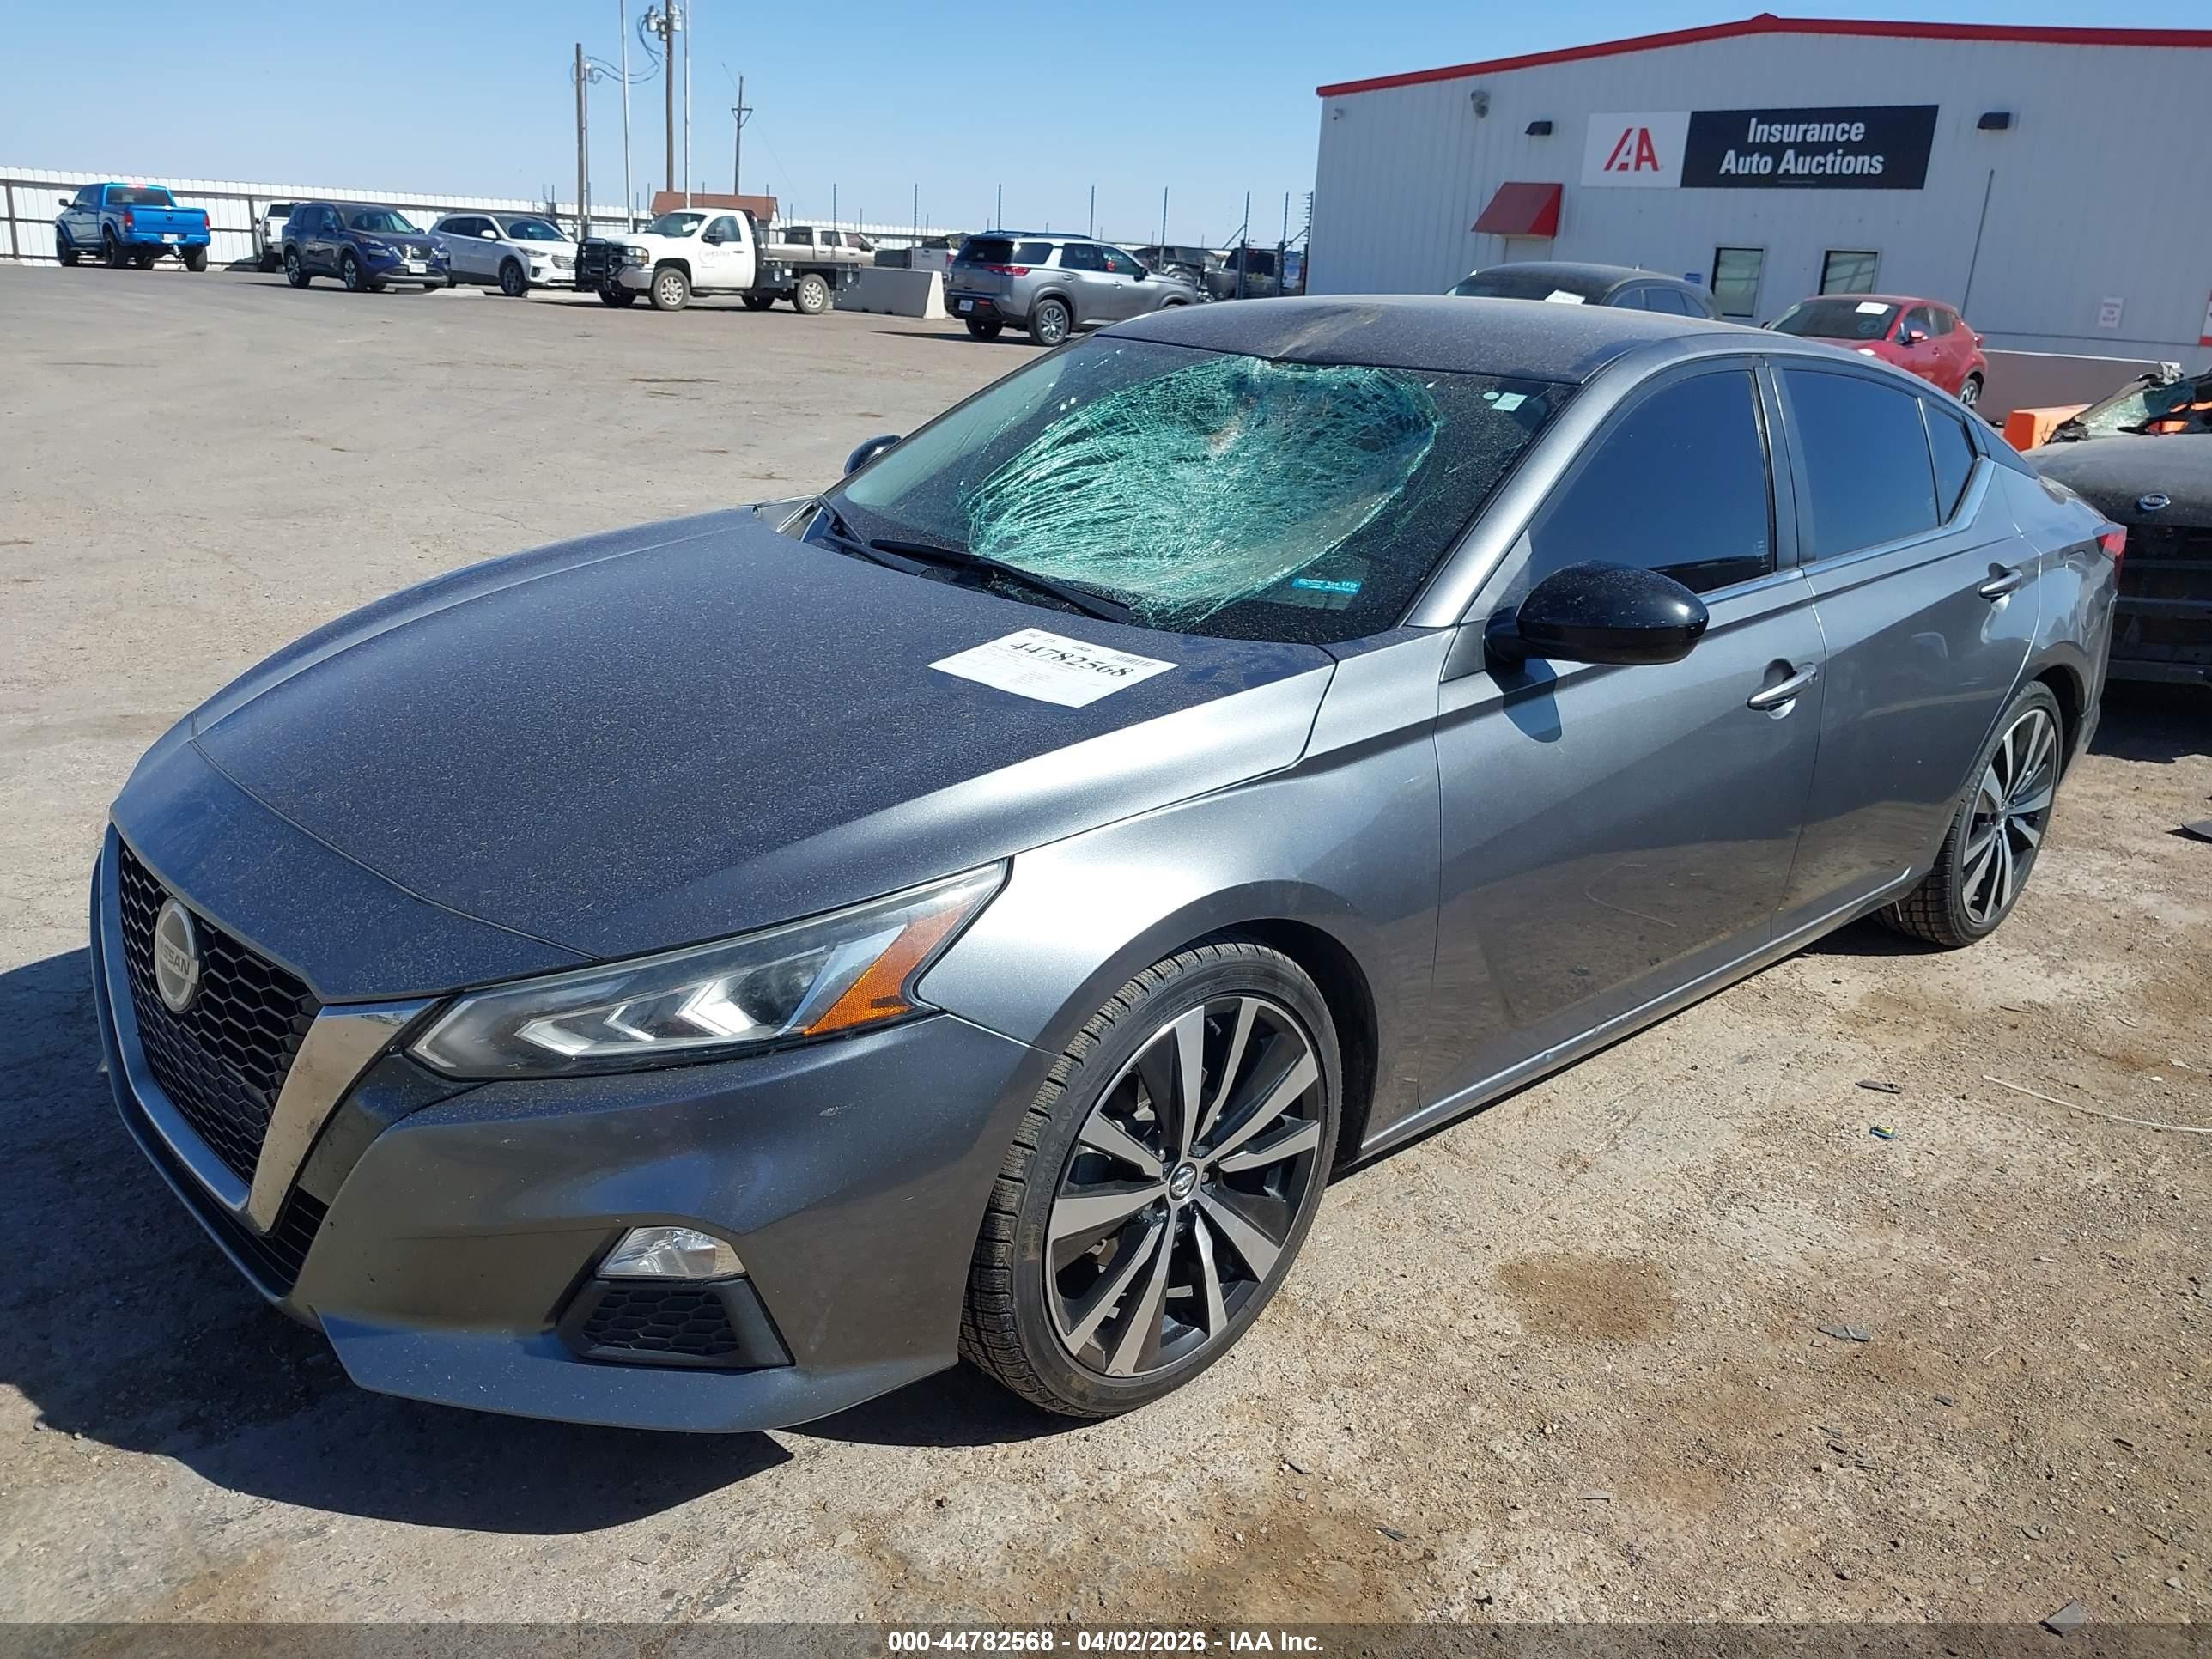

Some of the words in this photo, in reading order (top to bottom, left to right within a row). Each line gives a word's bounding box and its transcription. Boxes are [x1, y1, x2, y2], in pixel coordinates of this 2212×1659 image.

[1747, 118, 1866, 143] Insurance
[1719, 150, 1773, 175] Auto
[1778, 149, 1885, 175] Auctions
[1009, 641, 1134, 678] 44782568
[157, 934, 190, 976] SSAN
